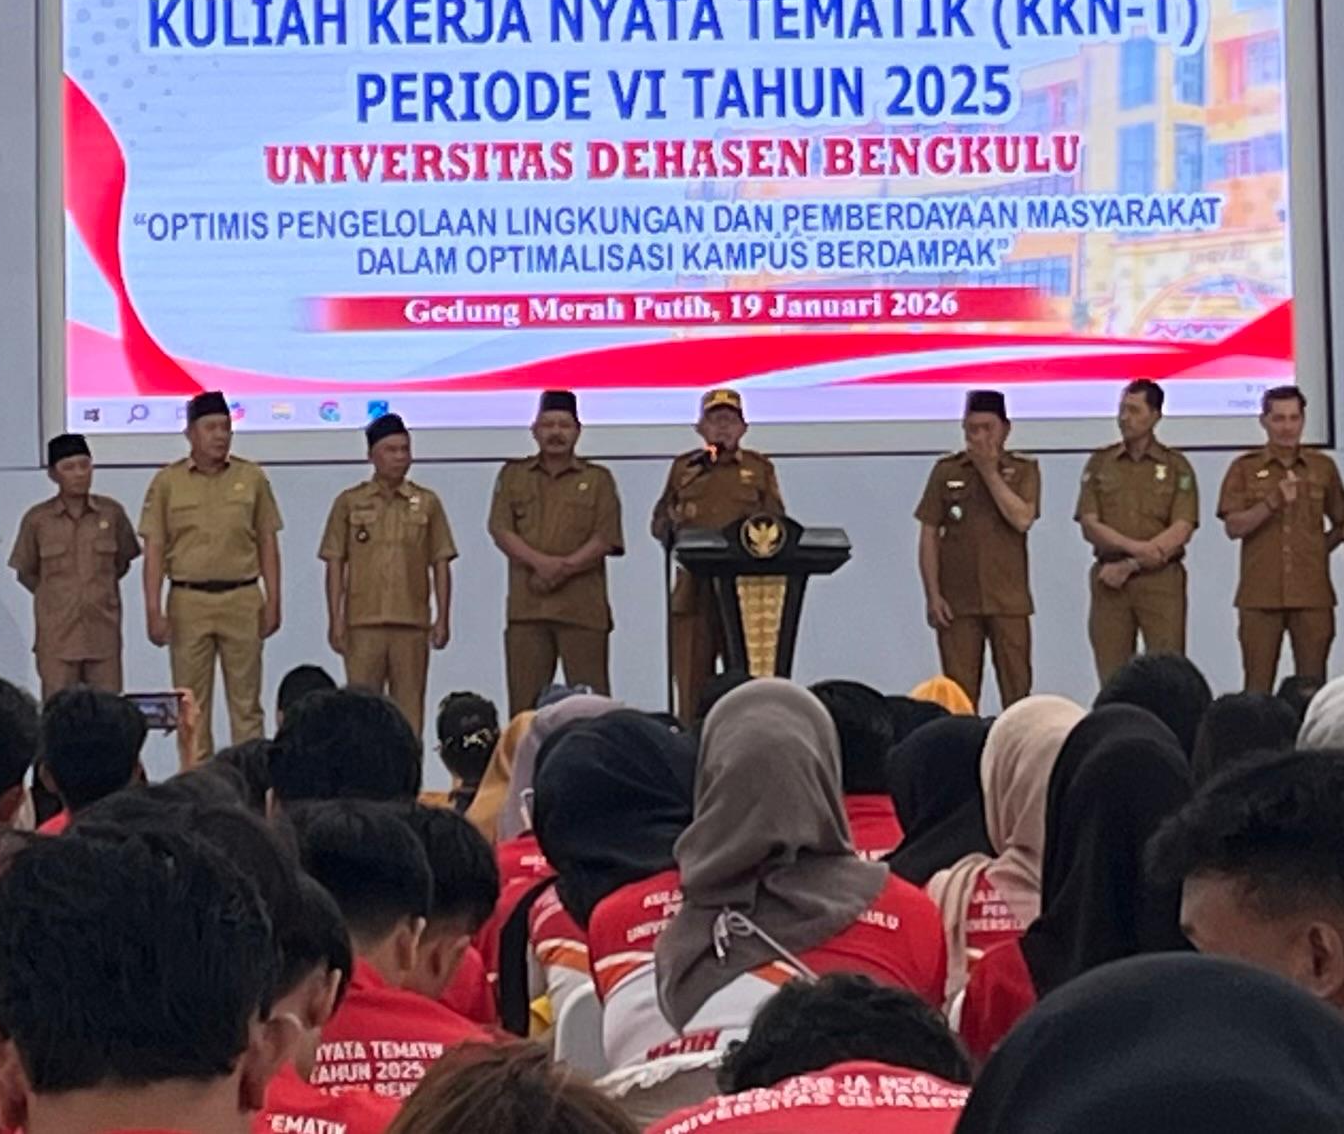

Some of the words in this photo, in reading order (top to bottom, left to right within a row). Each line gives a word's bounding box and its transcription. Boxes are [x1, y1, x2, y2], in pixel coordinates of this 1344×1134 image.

[357, 71, 591, 123] PERIODE
[608, 69, 666, 120] VI
[683, 68, 864, 119] TAHUN
[886, 64, 1012, 116] 2025
[264, 141, 573, 184] UNIVERSITAS
[587, 138, 809, 181] DEHASEN
[824, 135, 1080, 177] BENGKULU
[278, 208, 496, 240] PENGELOLAAN
[507, 206, 705, 237] LINGKUNGAN
[714, 204, 773, 234] DAN
[783, 200, 1018, 232] PEMBERDAYAAN
[1027, 197, 1222, 228] MASYARAKAT
[358, 247, 456, 276] DALAM
[466, 243, 673, 274] OPTIMALISASI
[682, 241, 807, 270] KAMPUS
[405, 298, 520, 327] Gedung
[529, 297, 623, 322] Merah
[633, 295, 720, 322] Putih,
[730, 295, 761, 318] 19
[768, 293, 881, 318] Januari
[891, 291, 958, 316] 2026
[376, 1060, 426, 1080] 2025
[266, 1114, 347, 1134] EMATIK
